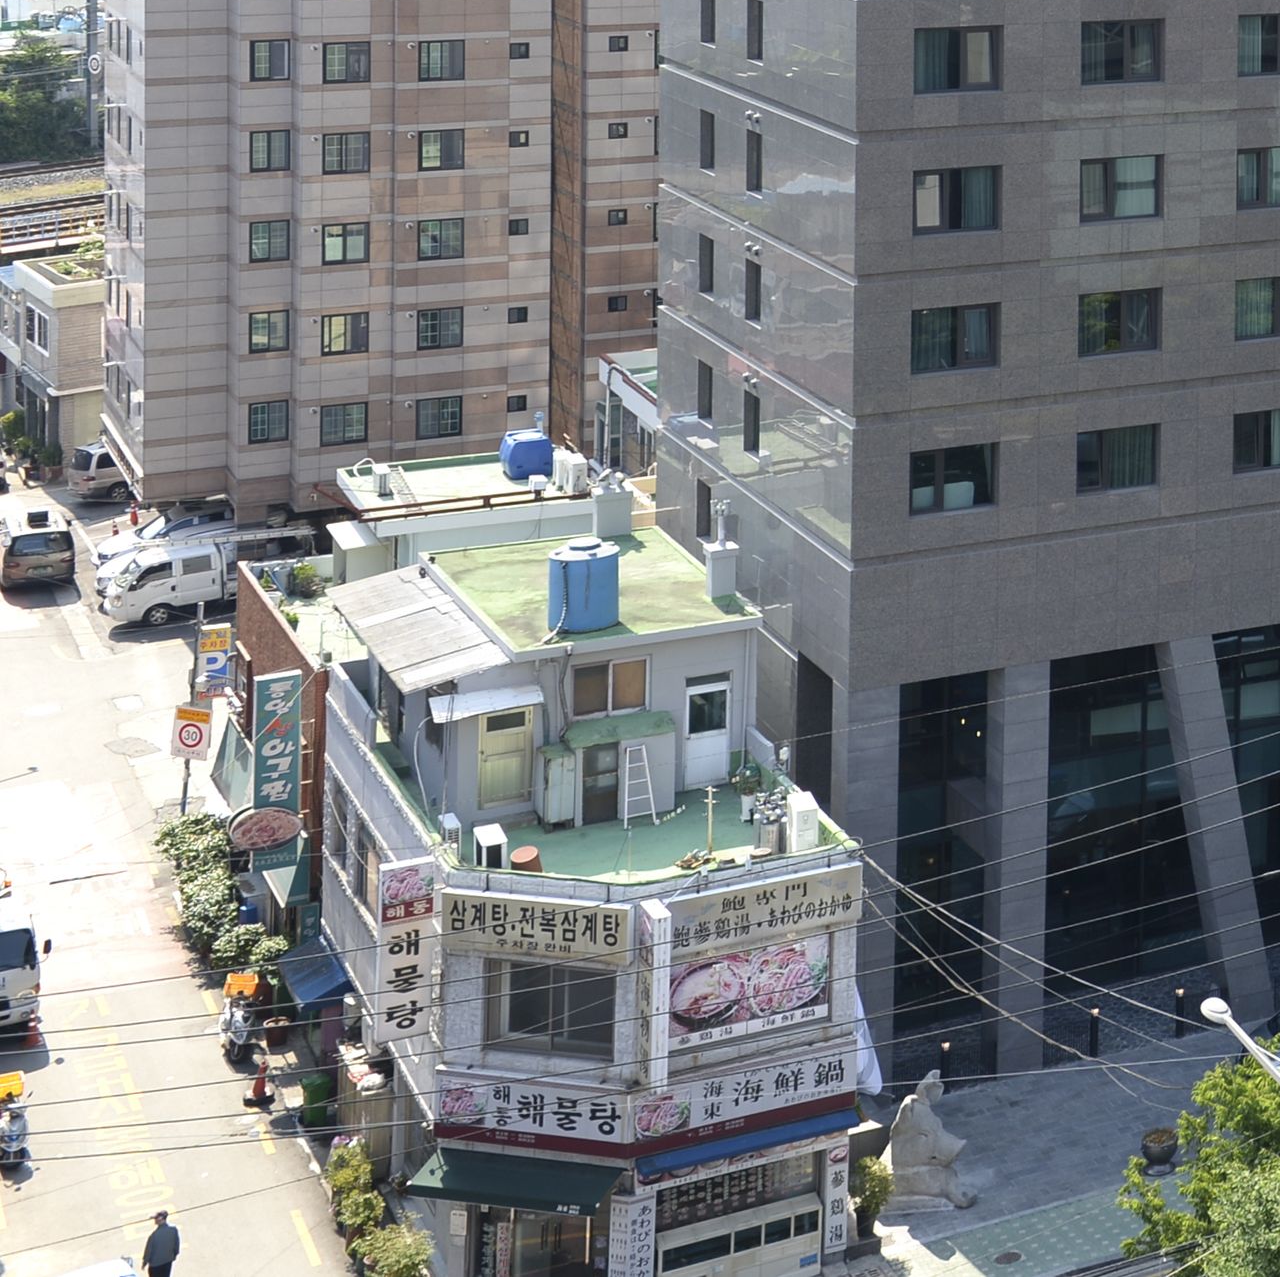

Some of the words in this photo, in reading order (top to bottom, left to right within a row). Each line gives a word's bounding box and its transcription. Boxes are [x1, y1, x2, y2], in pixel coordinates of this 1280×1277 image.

[200, 651, 227, 675] P
[183, 730, 198, 742] 30
[385, 902, 431, 919] 해동
[496, 938, 539, 951] 주차장
[384, 929, 425, 1030] 해물탕
[732, 1058, 846, 1108] 海鮮鍋
[516, 1093, 622, 1136] 해물탕
